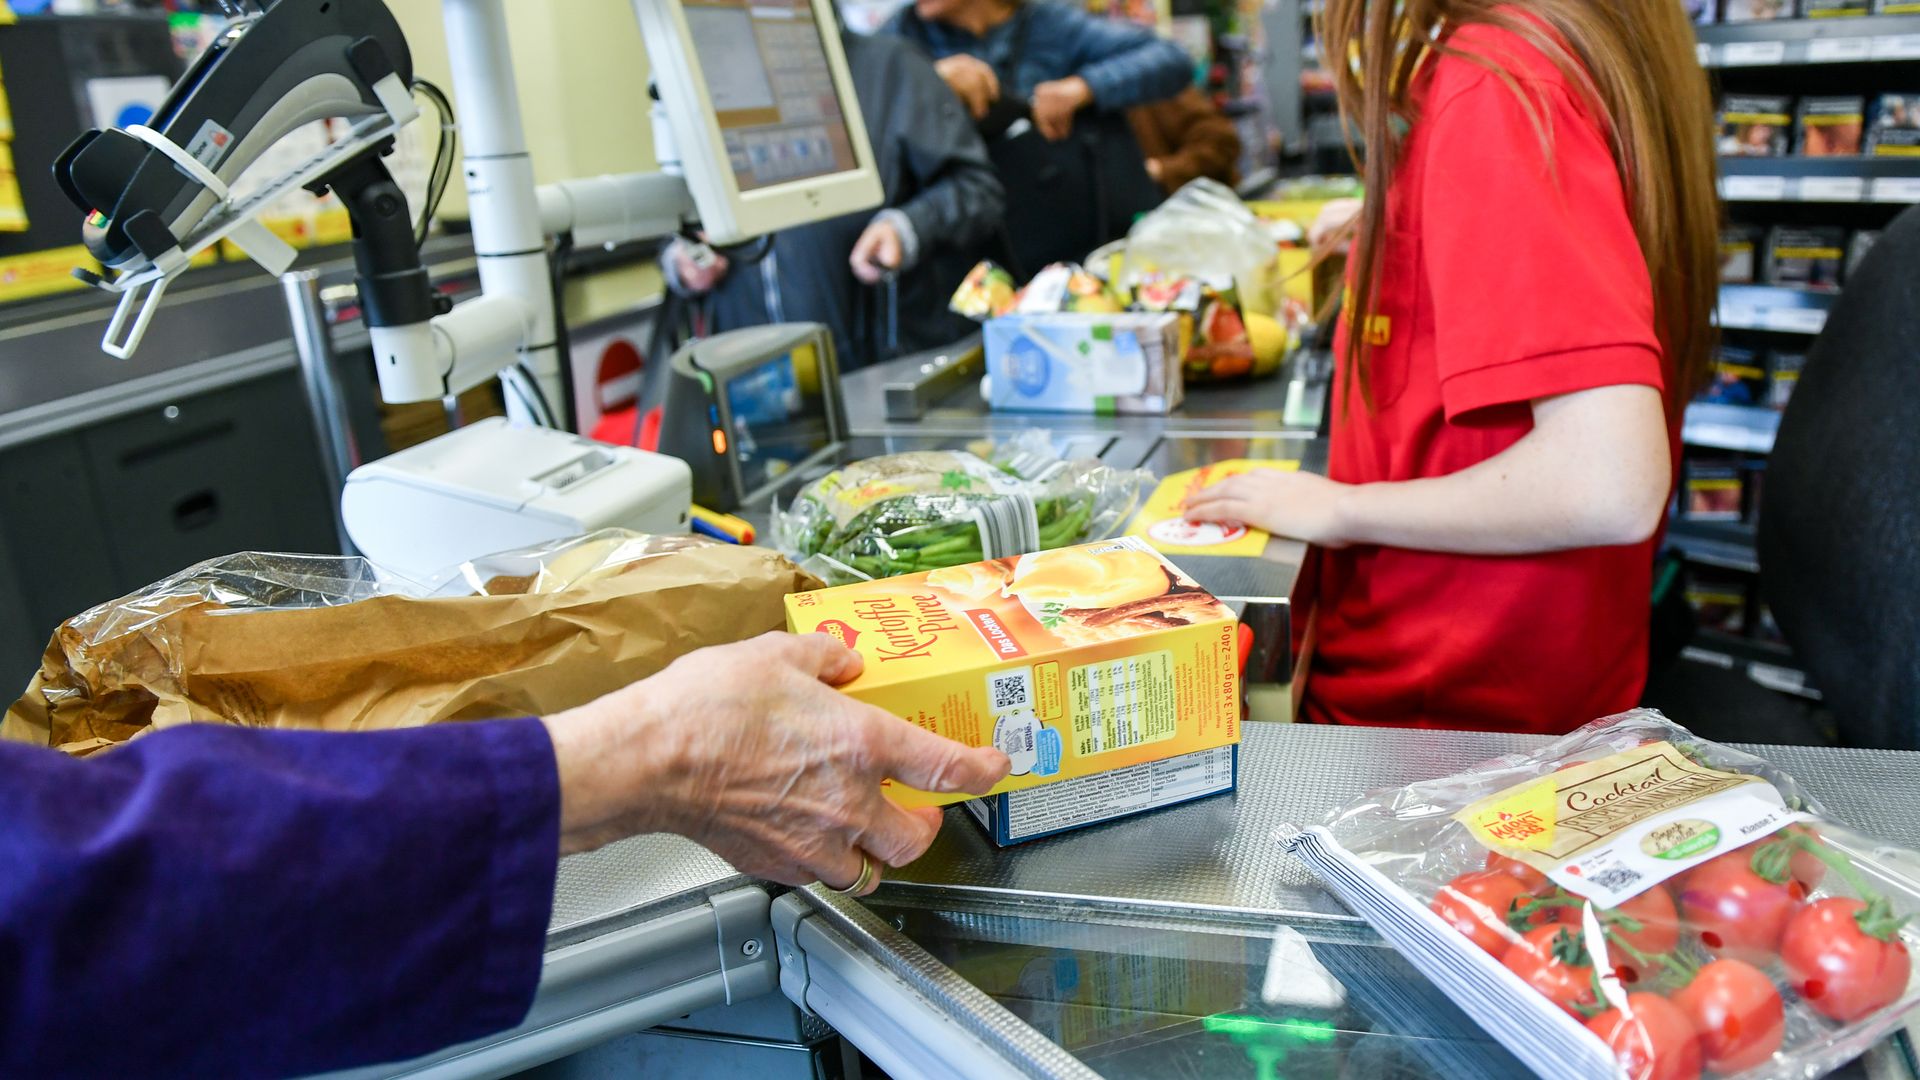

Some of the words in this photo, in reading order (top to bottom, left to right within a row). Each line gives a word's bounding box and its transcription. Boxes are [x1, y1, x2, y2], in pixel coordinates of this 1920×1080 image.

[912, 594, 959, 635] Püree
[978, 613, 1007, 639] Lockere
[854, 598, 937, 662] Kartoffel
[998, 638, 1018, 653] Das
[1221, 634, 1231, 653] 240
[1223, 681, 1233, 694] 80
[1564, 774, 1722, 829] RISPENTOMATEN
[1567, 767, 1669, 812] Cocktail
[1489, 815, 1543, 839] MARKT
[1508, 826, 1546, 841] TAG
[1740, 818, 1769, 834] Klasse
